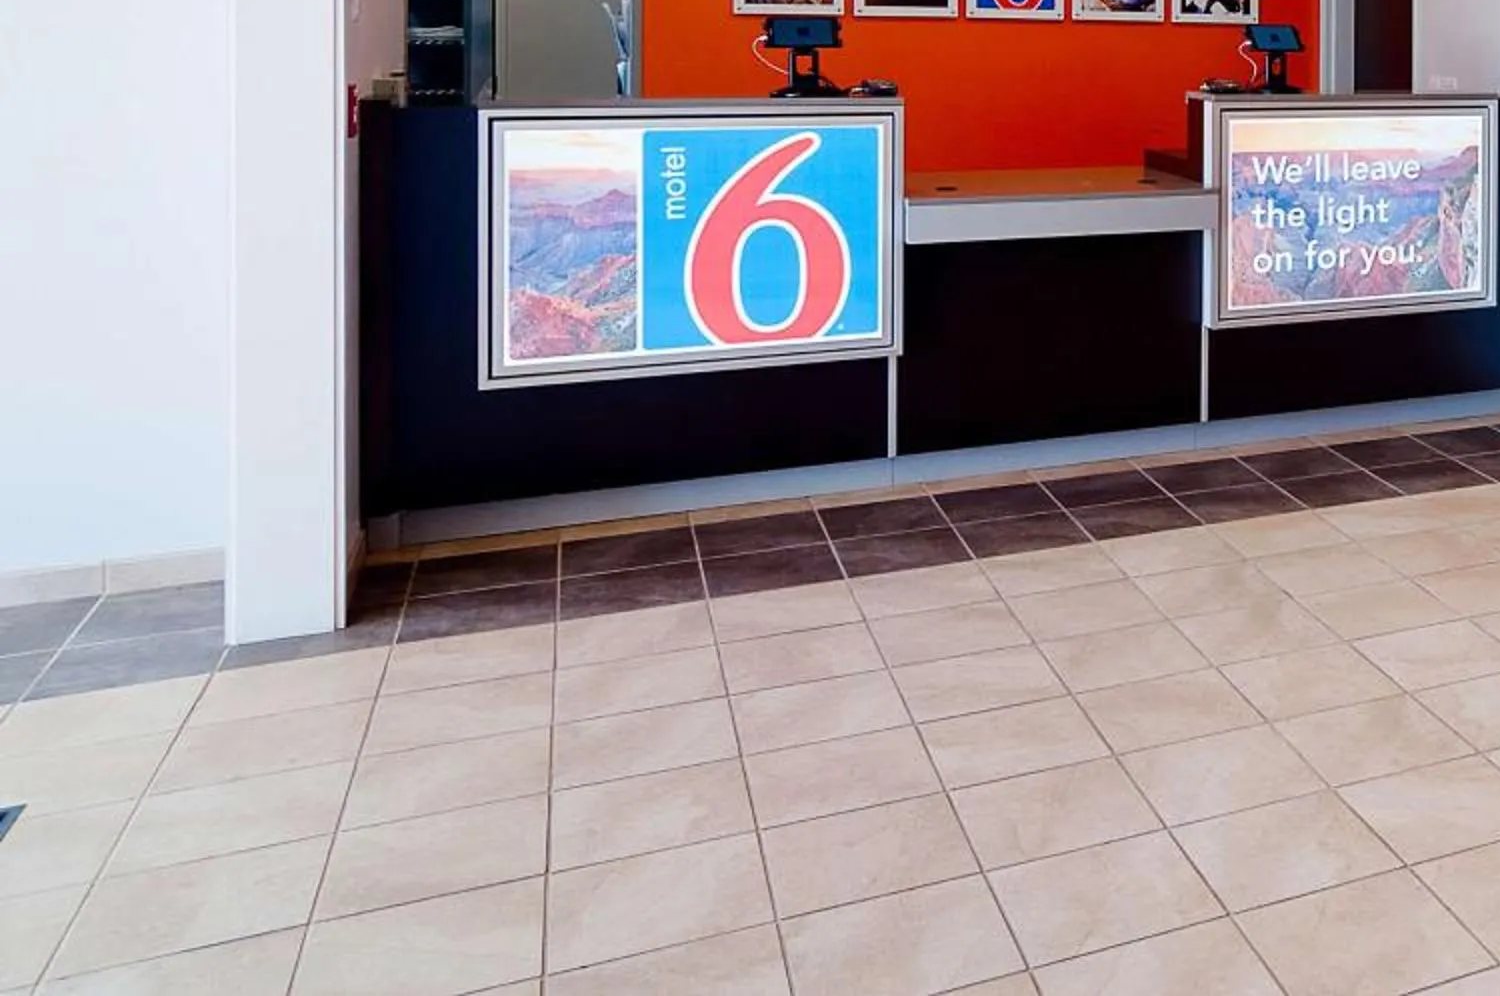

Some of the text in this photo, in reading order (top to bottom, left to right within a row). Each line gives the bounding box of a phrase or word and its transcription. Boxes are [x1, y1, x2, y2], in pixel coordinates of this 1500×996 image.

[1252, 152, 1421, 185] We'll leave
[1251, 194, 1390, 233] the light
[660, 131, 851, 345] motel 6
[1252, 250, 1293, 274] on
[1304, 240, 1348, 270] for
